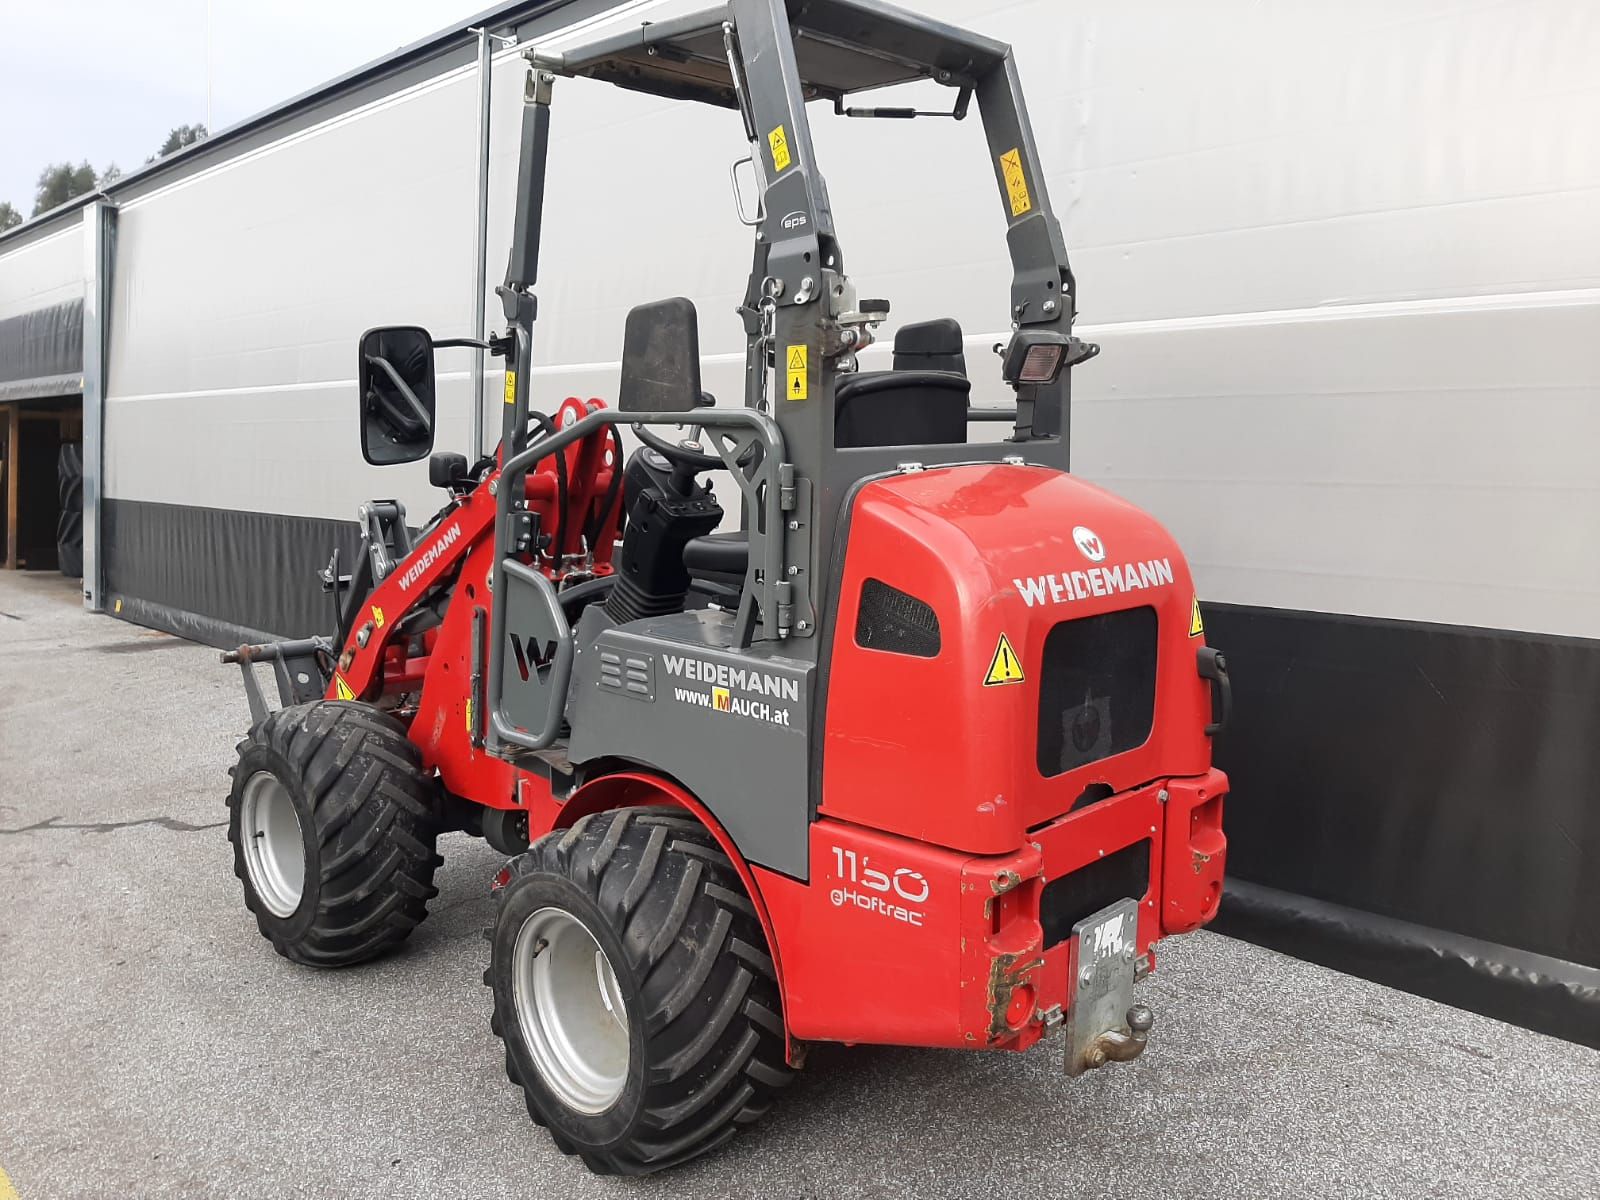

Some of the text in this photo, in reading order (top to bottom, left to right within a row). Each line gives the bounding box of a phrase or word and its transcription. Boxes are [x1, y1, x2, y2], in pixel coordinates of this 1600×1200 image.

[784, 215, 807, 229] eps
[398, 522, 461, 592] WEIDEMANN
[1013, 558, 1174, 607] WEIDEMANN
[662, 654, 799, 702] WEIDEMANN
[674, 685, 790, 726] www.MAUCH.at
[832, 846, 929, 903] 1150
